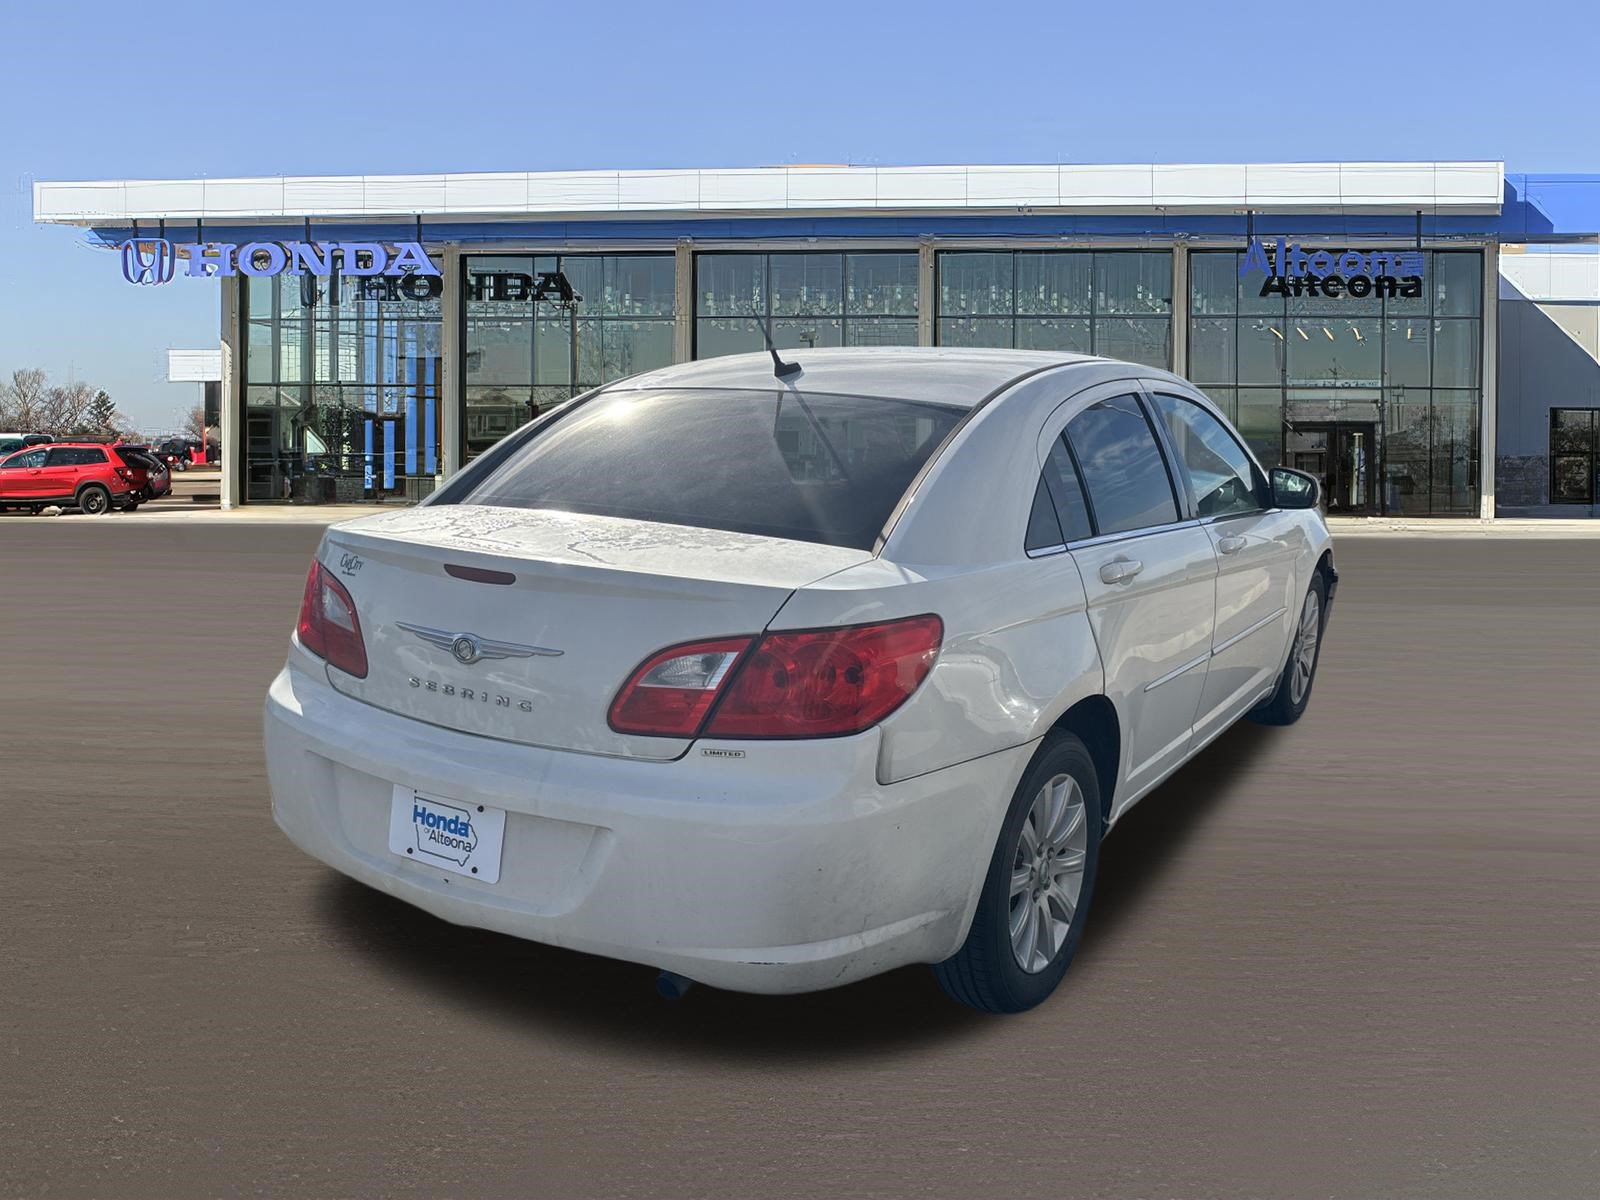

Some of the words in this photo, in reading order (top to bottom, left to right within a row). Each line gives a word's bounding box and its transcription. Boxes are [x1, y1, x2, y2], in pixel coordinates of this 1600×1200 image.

[184, 242, 442, 277] HONDA
[408, 675, 534, 713] SEBRING
[413, 804, 469, 838] Honda
[429, 829, 472, 853] Altoona
